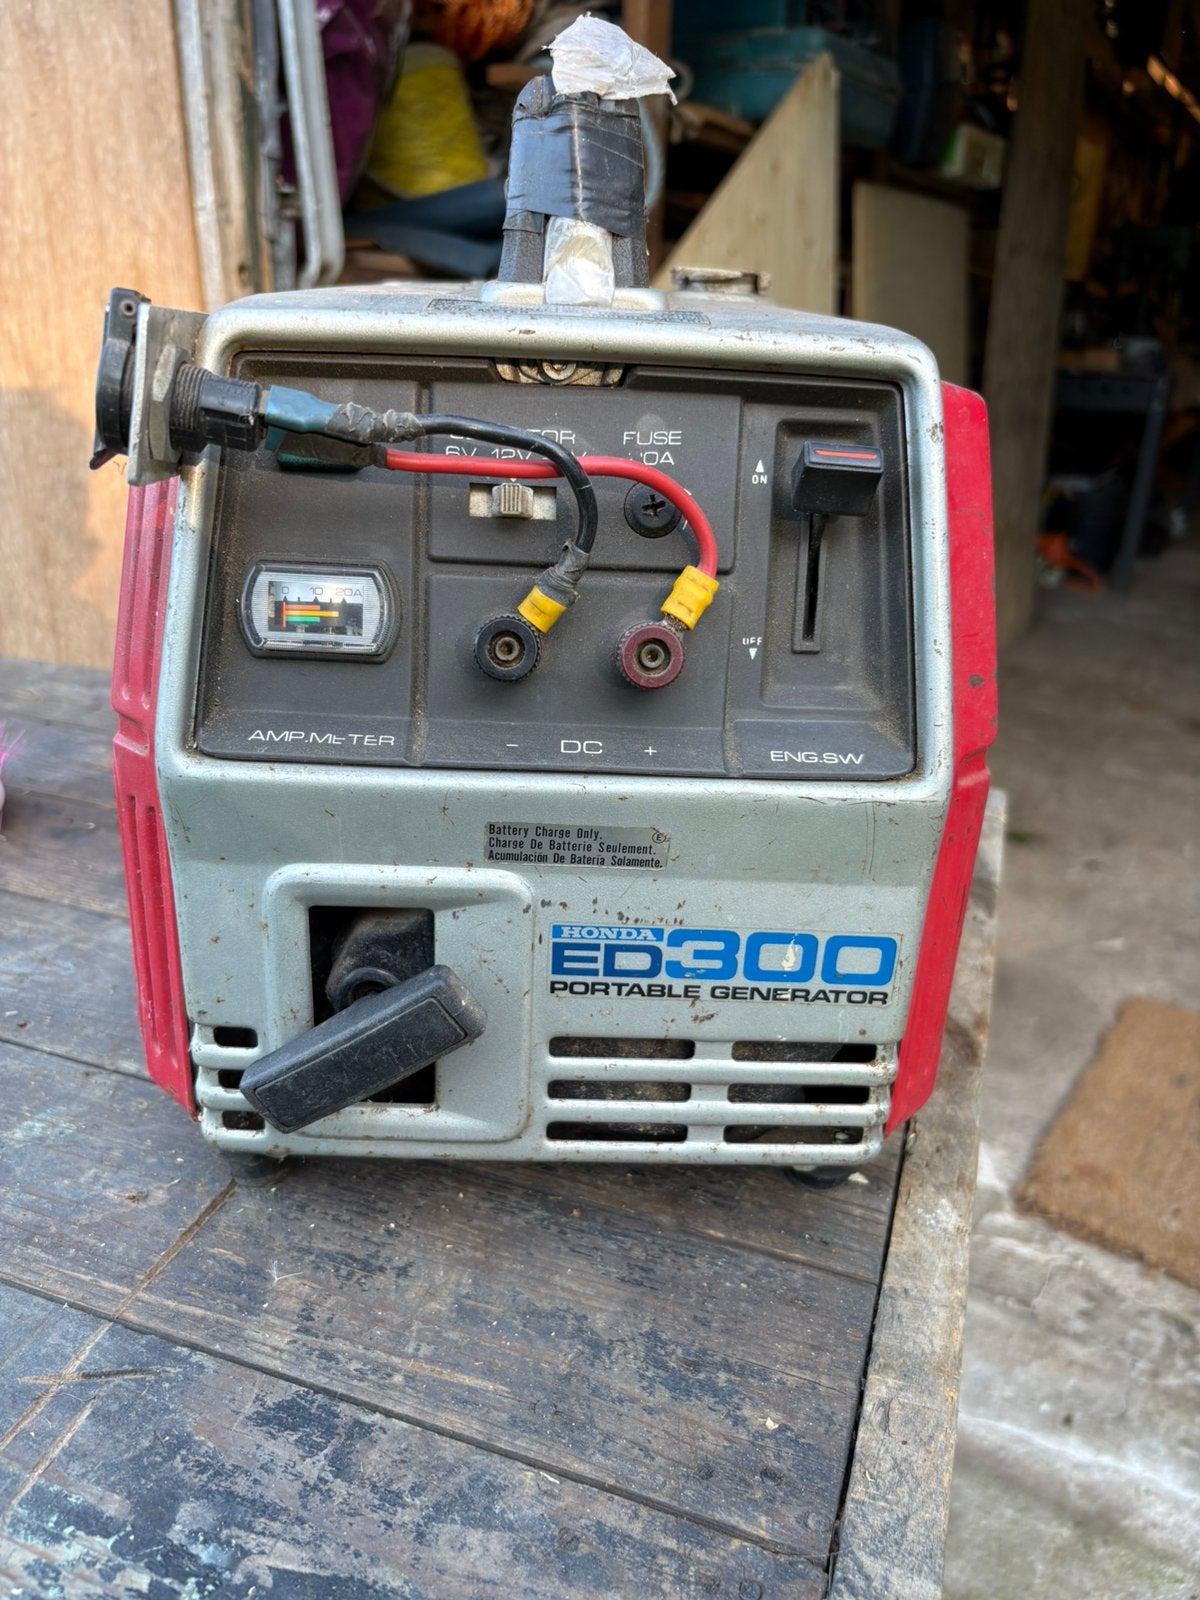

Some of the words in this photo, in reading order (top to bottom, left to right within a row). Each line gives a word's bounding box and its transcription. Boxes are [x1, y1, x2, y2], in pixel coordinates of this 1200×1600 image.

[623, 431, 682, 446] FUSE
[752, 475, 767, 484] ON
[310, 586, 324, 596] 10
[335, 587, 362, 597] 20A
[248, 729, 395, 746] AMP.METER
[560, 740, 603, 754] DC
[770, 750, 863, 765] ENG.SW
[488, 823, 529, 839] Battery
[535, 826, 571, 839] Charge
[576, 828, 603, 842] Only.
[488, 836, 525, 850] Charge
[530, 839, 543, 850] De
[549, 840, 592, 853] Batterie
[598, 841, 657, 856] Seulement.
[487, 849, 548, 864] Acumulación
[553, 852, 566, 864] De
[610, 855, 664, 869] Solamente.
[560, 926, 657, 941] HONDA
[551, 928, 898, 987] ED300
[550, 980, 702, 999] PORTABLE
[709, 985, 889, 1006] GENERATOR
